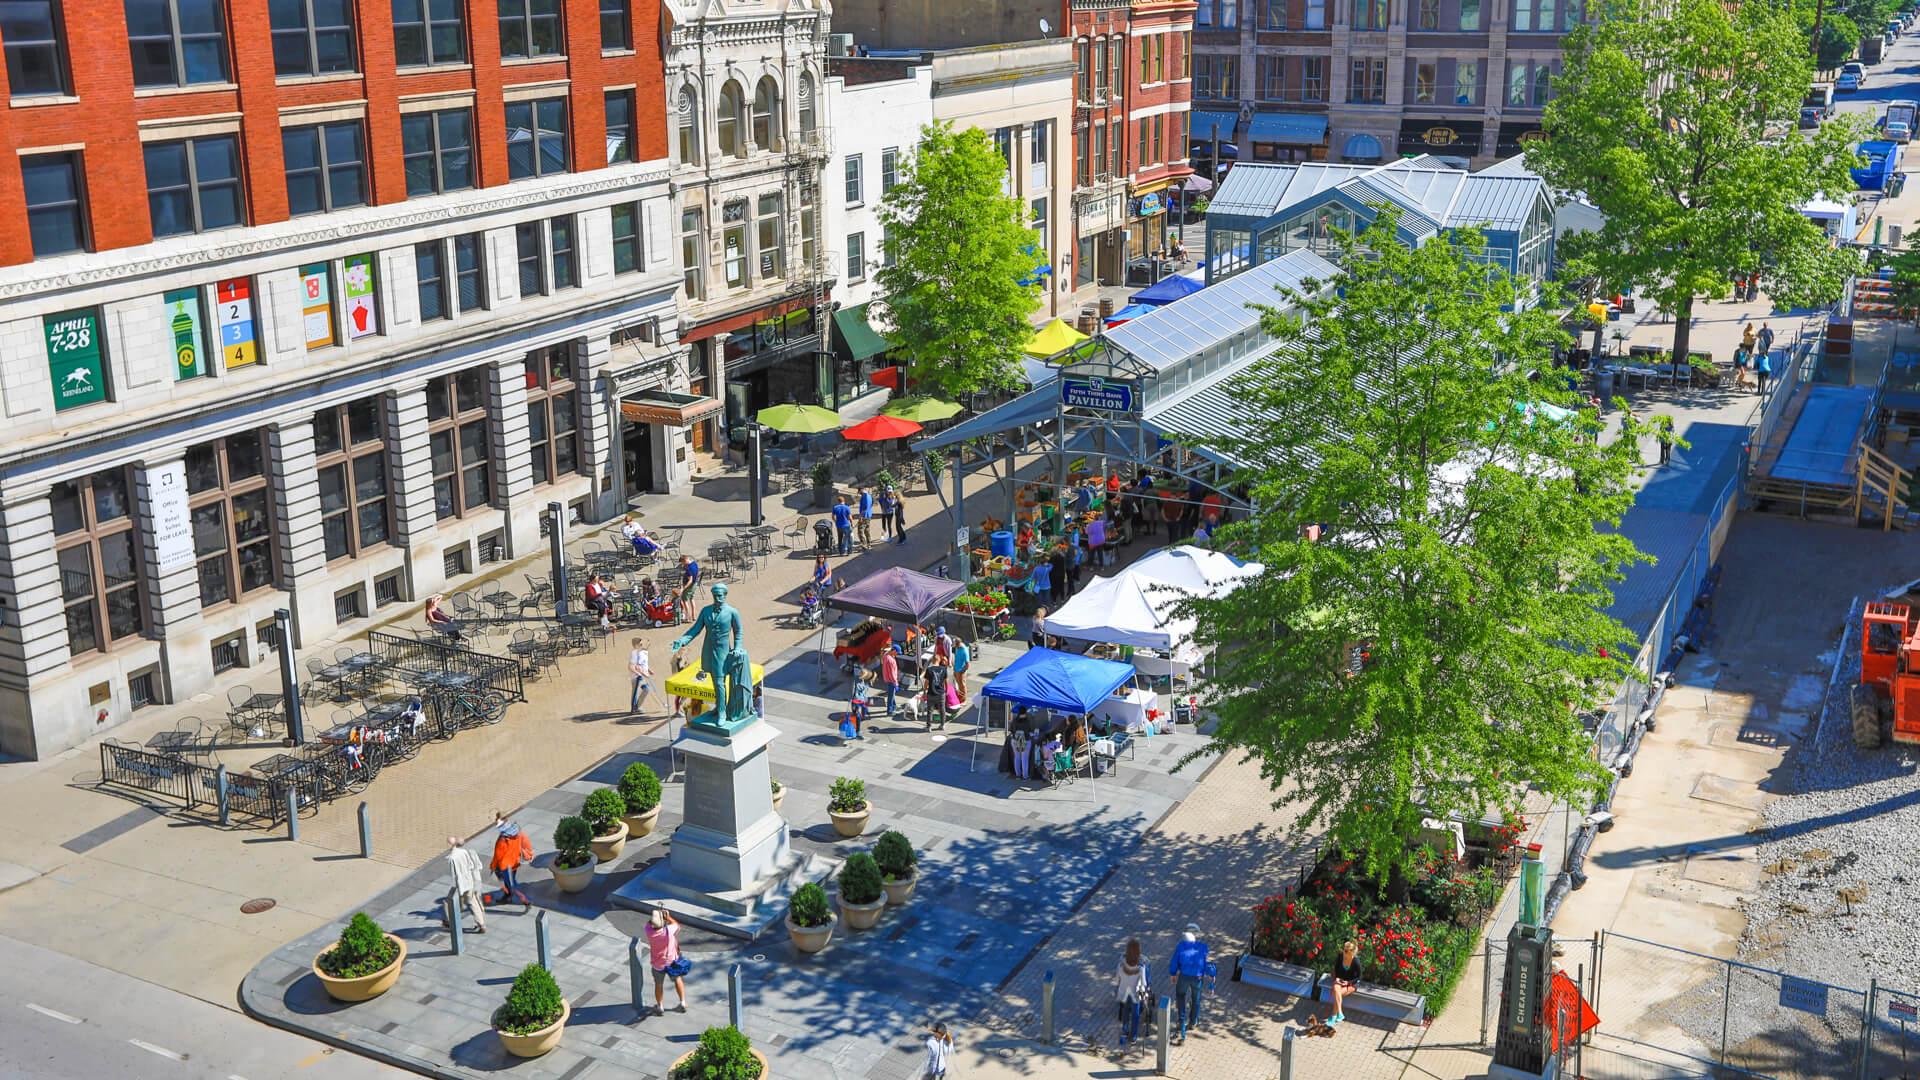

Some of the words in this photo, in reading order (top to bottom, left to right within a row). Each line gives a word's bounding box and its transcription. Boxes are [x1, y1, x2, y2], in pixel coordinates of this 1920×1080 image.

[227, 283, 236, 297] 1
[230, 305, 239, 320] 2
[51, 317, 90, 335] APRIL
[232, 325, 242, 340] 3
[50, 329, 90, 354] 7-28
[235, 346, 244, 361] 4
[1068, 394, 1123, 409] PAVILION
[162, 500, 178, 508] Office
[159, 534, 171, 542] FOR
[171, 528, 188, 538] LEASE
[674, 687, 698, 696] KETTLE
[1516, 965, 1528, 1024] CHEAPSIDE
